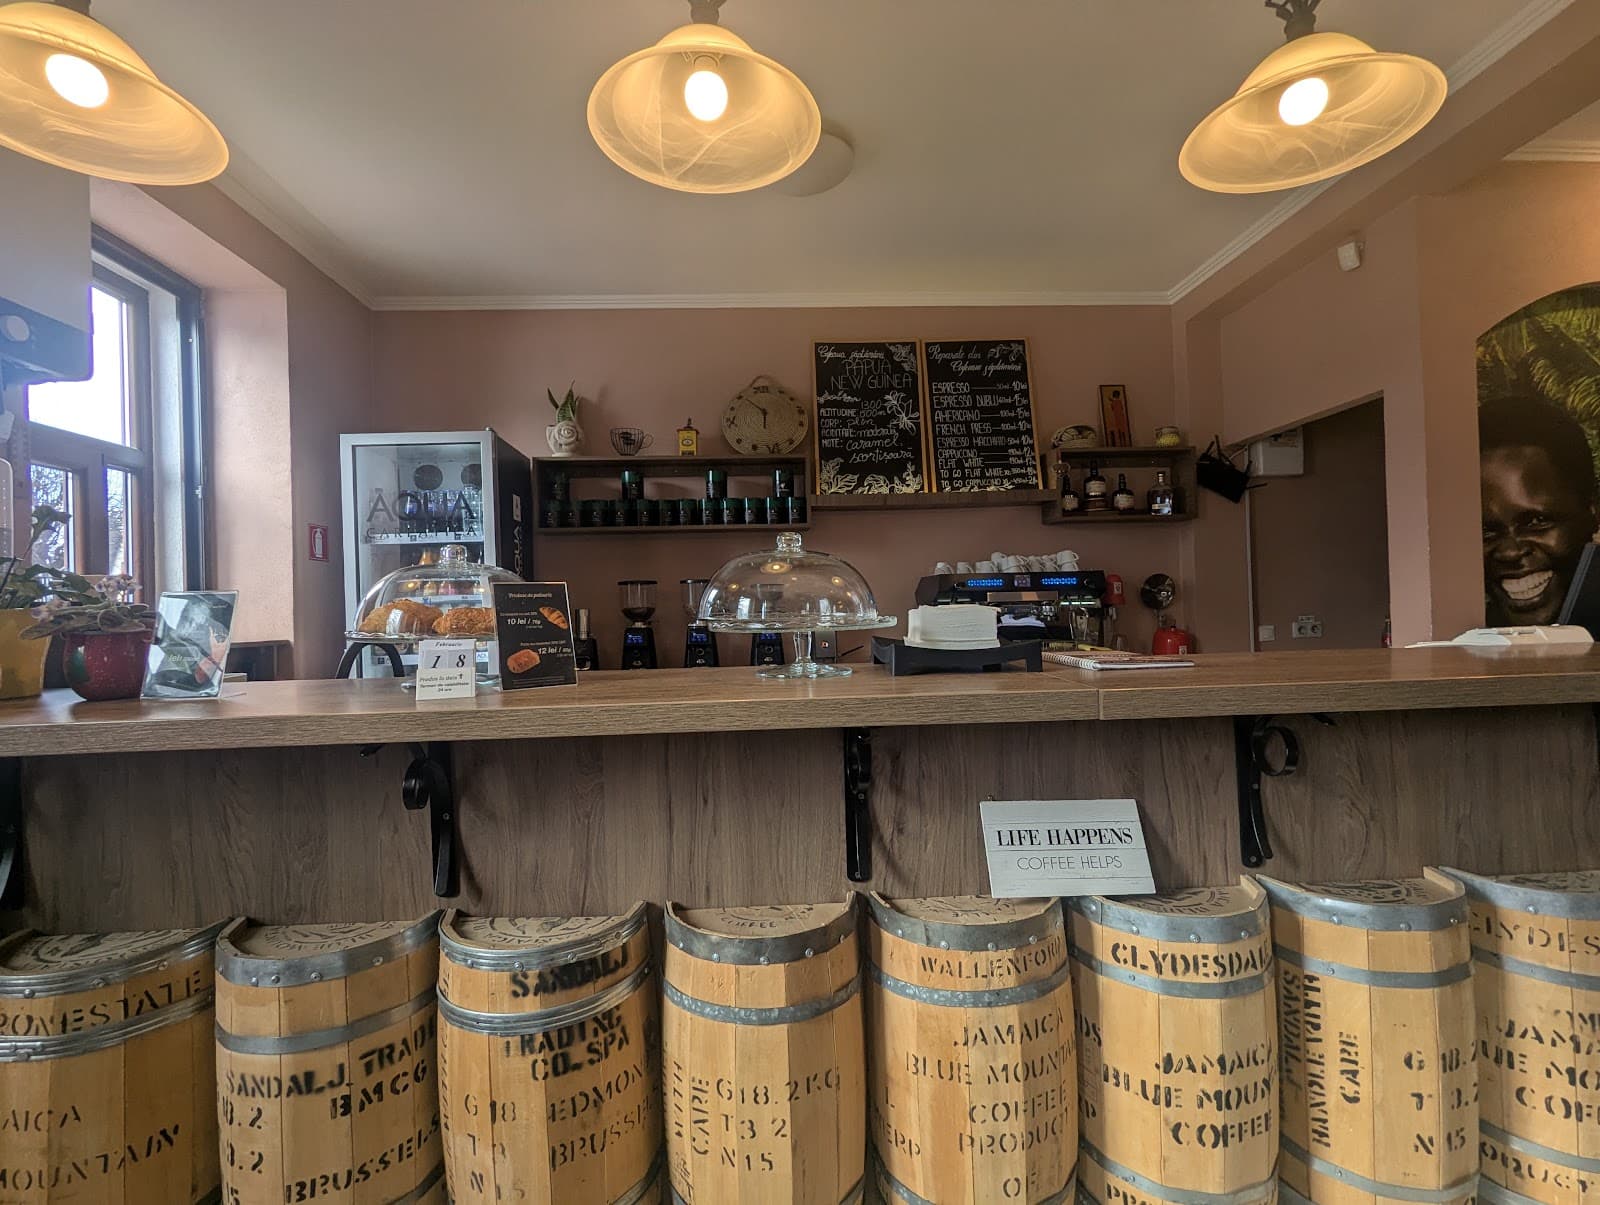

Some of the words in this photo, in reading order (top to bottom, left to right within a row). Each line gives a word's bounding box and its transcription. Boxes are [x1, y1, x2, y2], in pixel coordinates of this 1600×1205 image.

[830, 375, 866, 391] NEW
[932, 382, 970, 395] ESPRESSO
[933, 396, 973, 408] ESPRESSO
[935, 409, 980, 423] AMERICANO
[936, 423, 967, 435] FRENCH
[937, 437, 970, 448] ESPRESSO
[938, 459, 957, 469] FLAT
[456, 653, 466, 668] 8
[997, 828, 1041, 847] LIFE
[1047, 827, 1133, 846] HAPPENS
[1017, 856, 1075, 870] COFFEE
[1081, 855, 1123, 869] HELPS
[953, 1007, 1064, 1047] JAMAICA
[586, 1026, 630, 1064] SPA
[905, 1051, 972, 1086] BLUE
[1338, 1031, 1361, 1105] CARE
[1102, 1063, 1184, 1110] BLUE
[967, 1079, 1067, 1125] COFFEE
[691, 1075, 710, 1157] CARE
